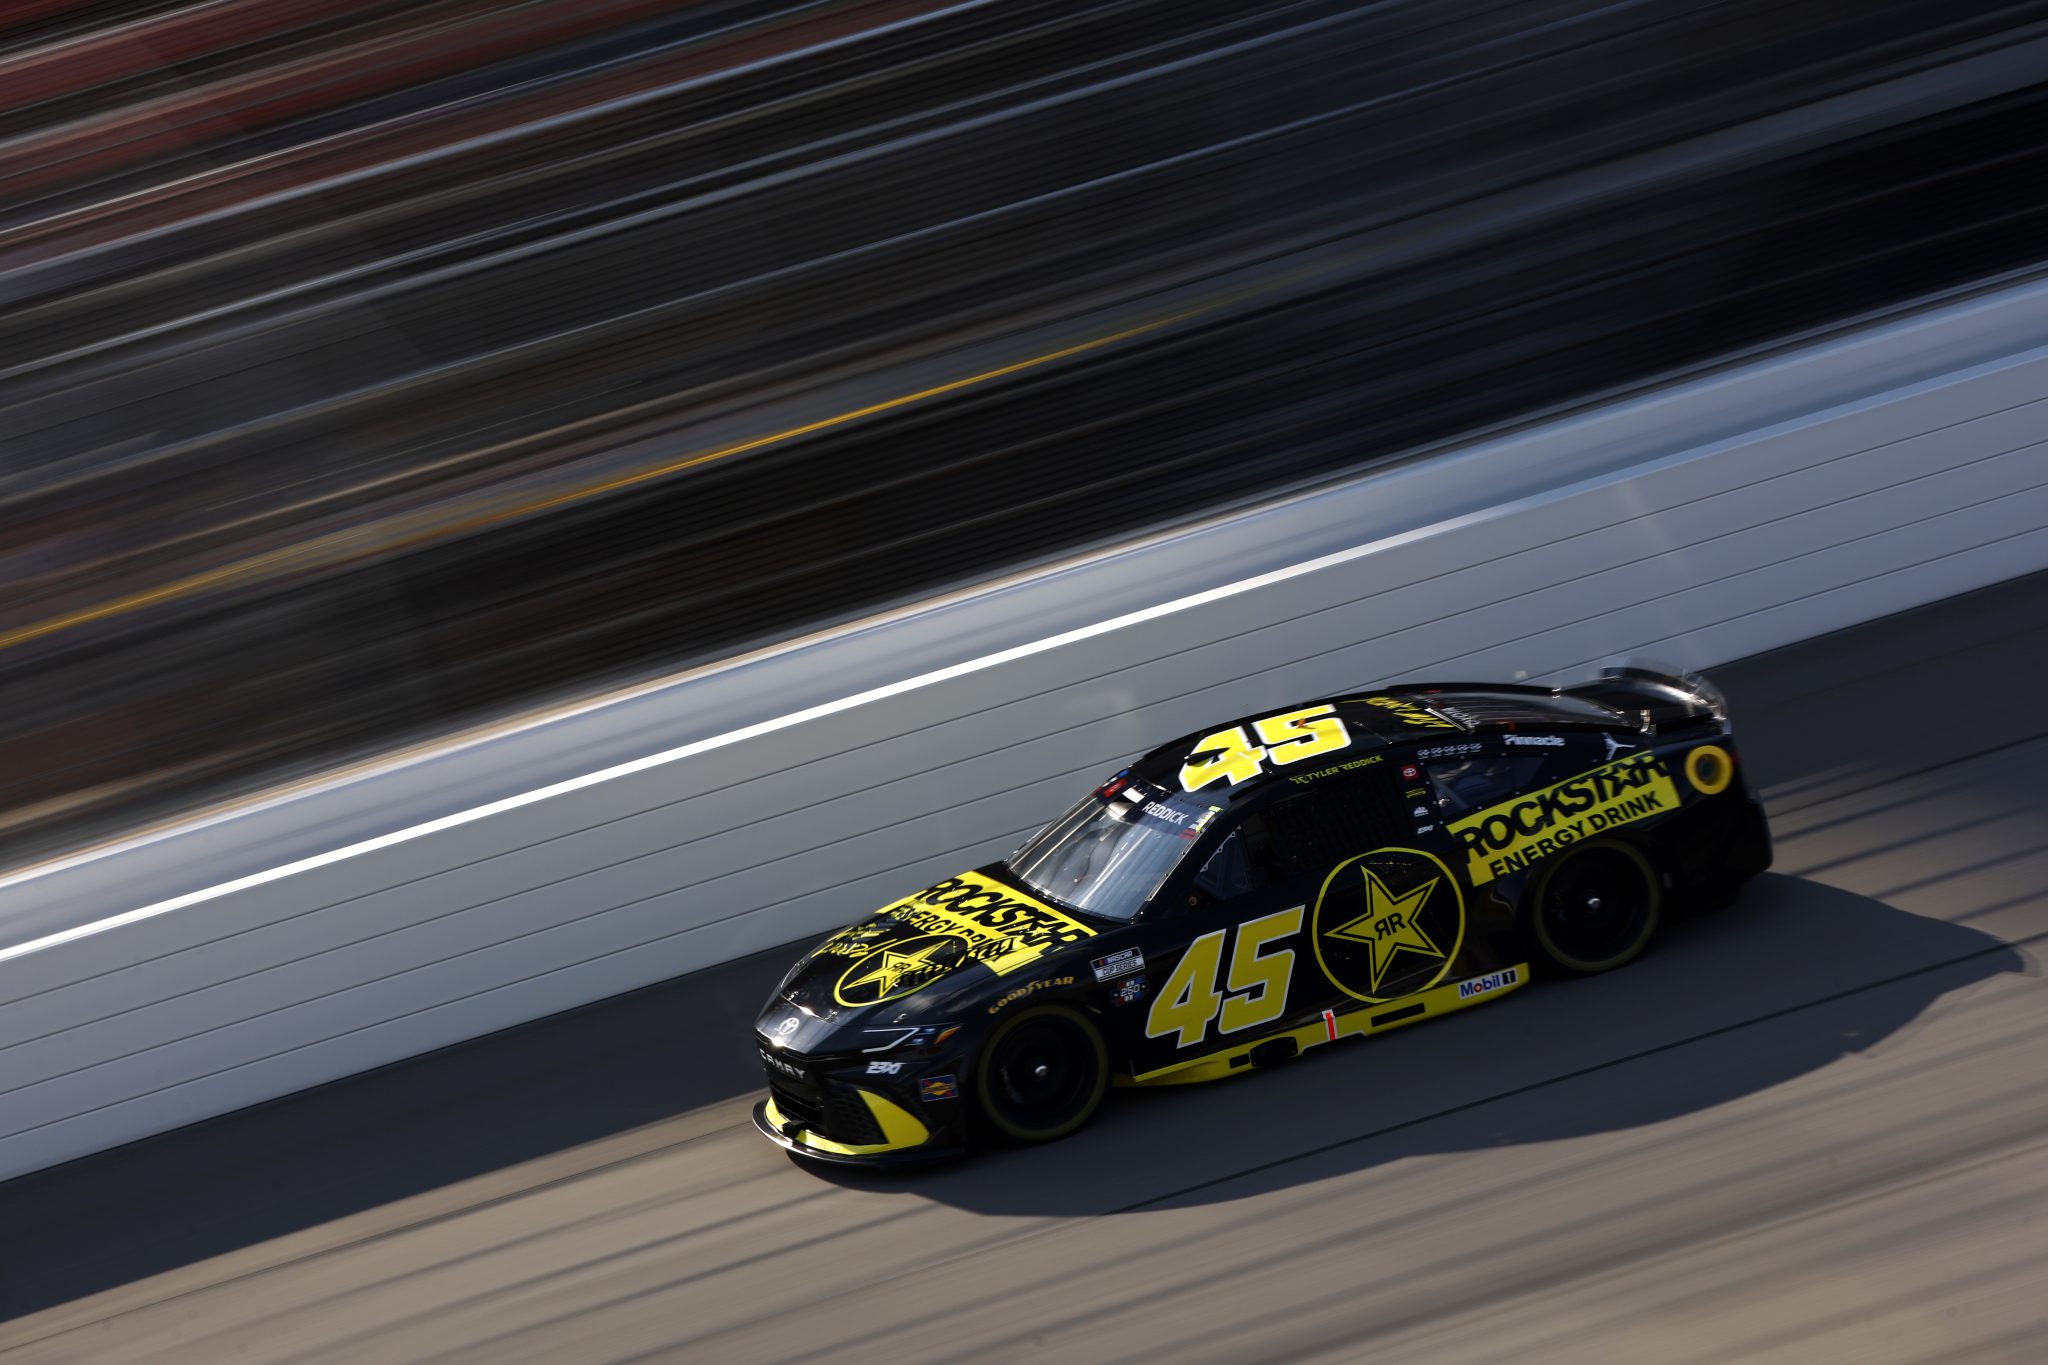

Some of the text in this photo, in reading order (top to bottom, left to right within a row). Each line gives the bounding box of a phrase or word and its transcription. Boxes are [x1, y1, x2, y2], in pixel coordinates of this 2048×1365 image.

[1178, 703, 1352, 793] 45
[1306, 766, 1340, 781] TYLER
[1338, 754, 1384, 771] REDDICK
[1141, 801, 1189, 825] REDDICK
[1454, 757, 1672, 863] ROCKSTAR
[1488, 791, 1664, 877] ENERGY DRINK
[1107, 950, 1133, 964] NASCAR
[1145, 904, 1306, 1049] 45
[1460, 970, 1515, 998] Mobil 1
[987, 975, 1076, 1016] GOODYEAR
[759, 1048, 806, 1079] CAMRY
